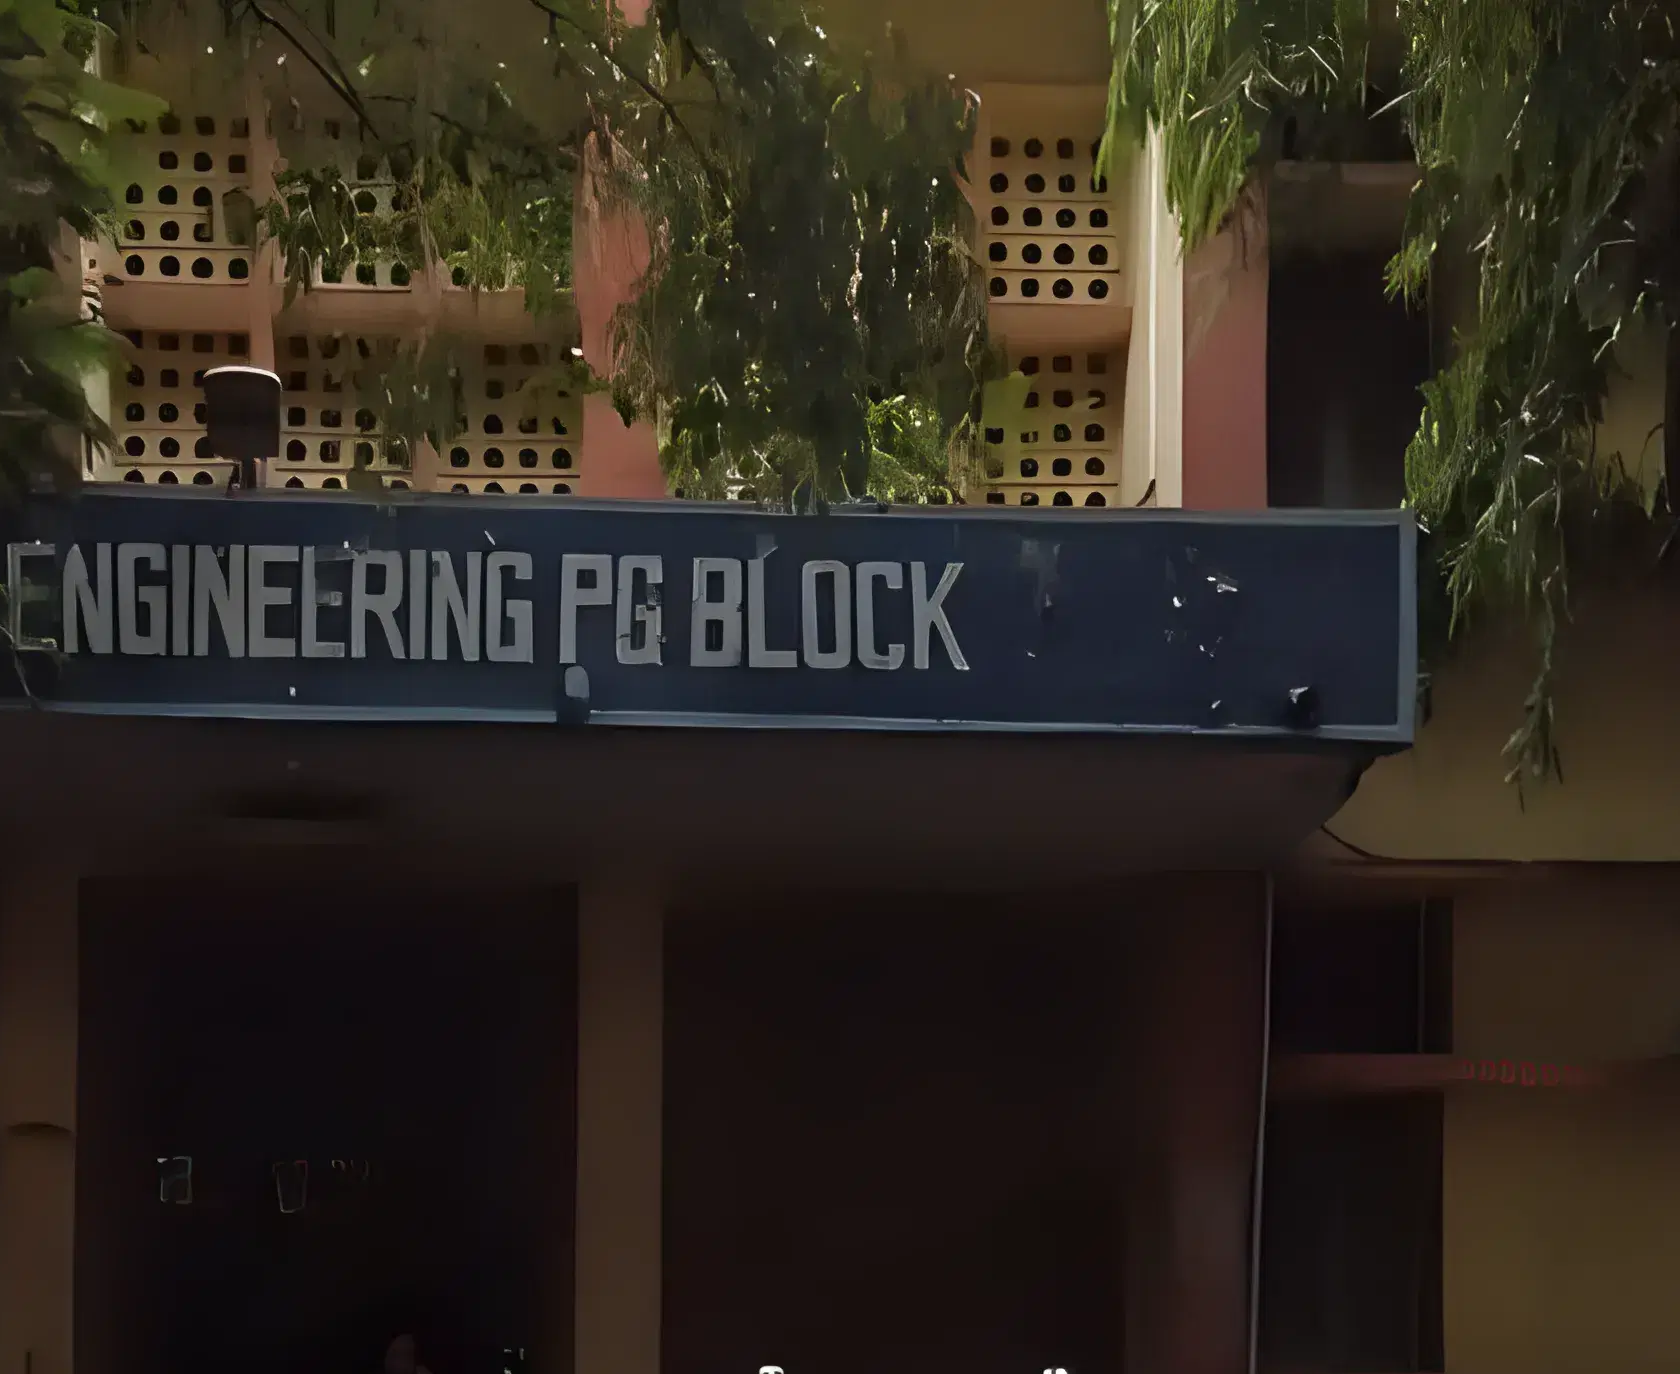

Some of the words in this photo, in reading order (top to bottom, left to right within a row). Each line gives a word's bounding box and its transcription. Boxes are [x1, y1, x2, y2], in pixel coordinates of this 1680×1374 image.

[6, 541, 535, 664] ENGINEERING
[559, 553, 663, 666] PG
[690, 556, 971, 670] BLOCK
